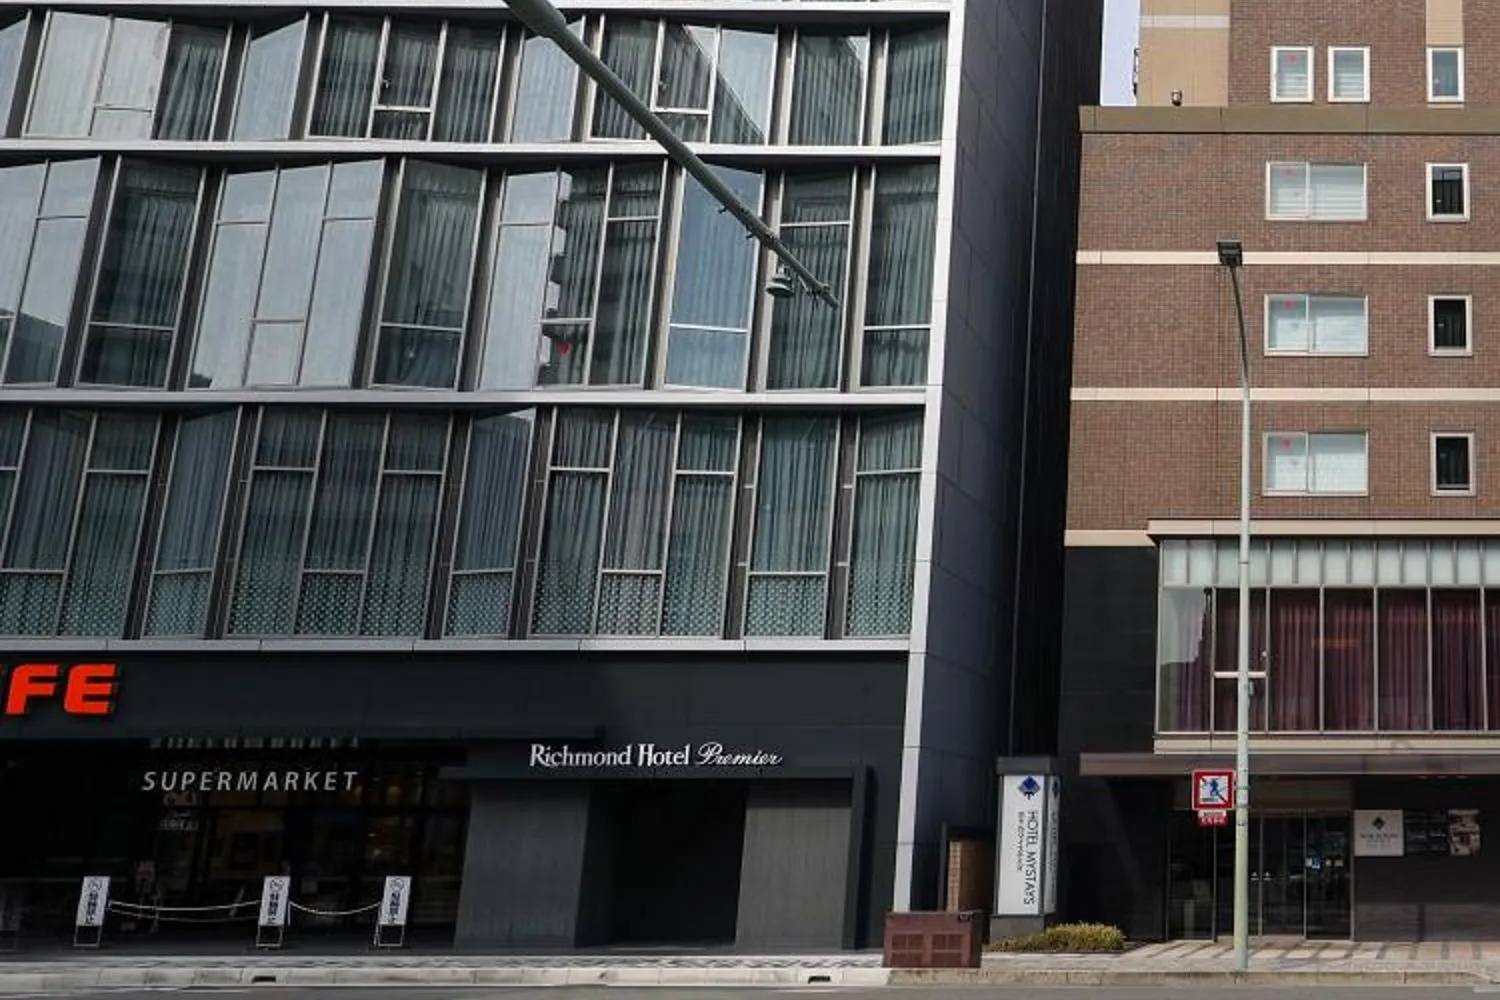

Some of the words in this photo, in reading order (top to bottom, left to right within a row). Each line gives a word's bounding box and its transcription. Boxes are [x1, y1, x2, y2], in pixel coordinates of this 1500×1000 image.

[0, 664, 116, 714] FE
[530, 743, 631, 767] Richmond
[637, 743, 690, 767] Hotel
[697, 741, 783, 767] Premier
[141, 771, 359, 791] SUPERMARKET
[1025, 810, 1039, 848] HOTEL
[1023, 850, 1038, 905] MYSTAYS
